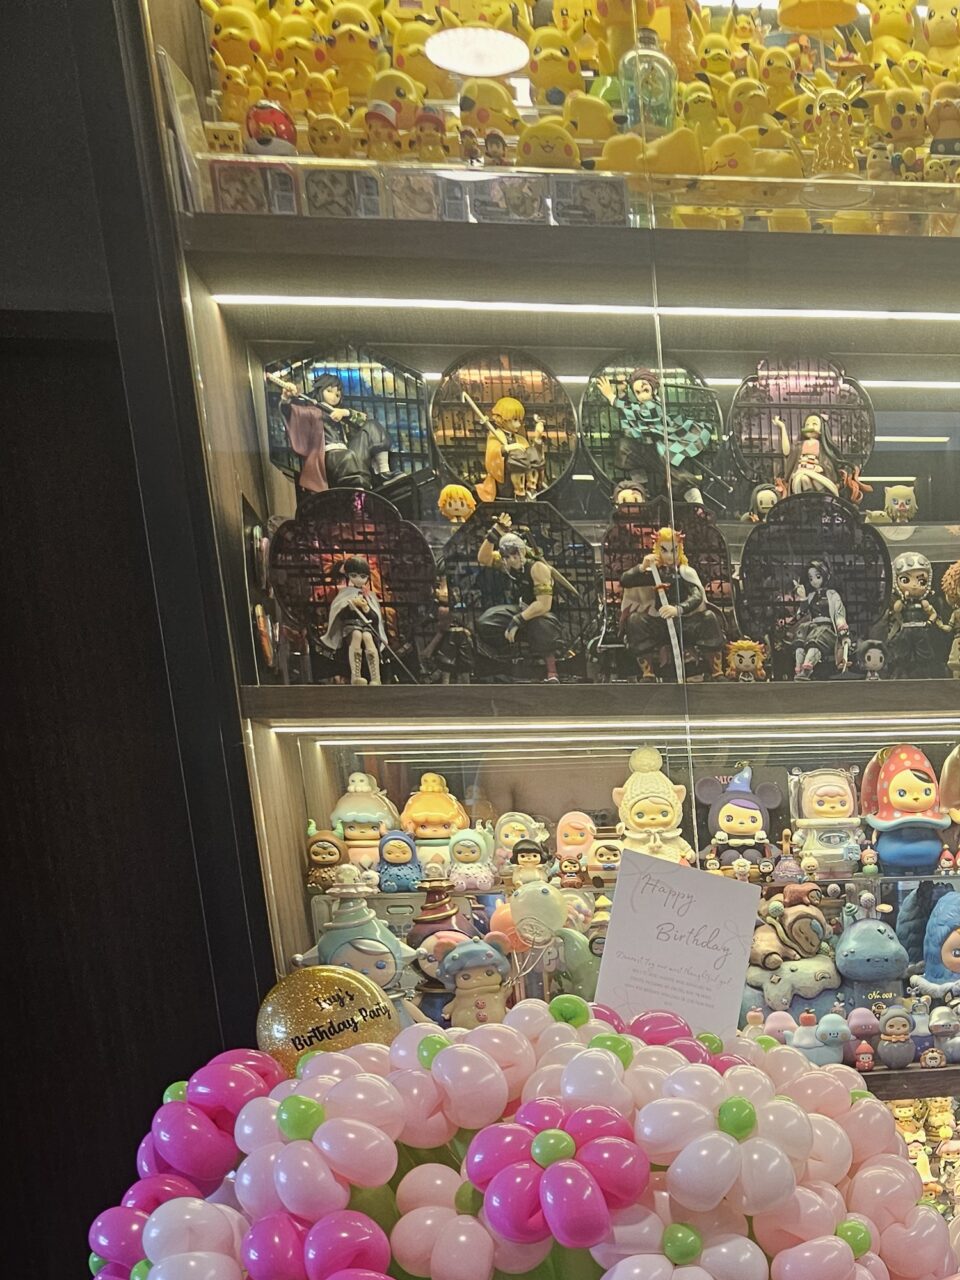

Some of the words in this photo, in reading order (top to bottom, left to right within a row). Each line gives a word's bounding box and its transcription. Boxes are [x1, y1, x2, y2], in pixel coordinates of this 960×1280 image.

[640, 873, 697, 917] Happy
[655, 921, 733, 970] Birthday
[290, 1016, 359, 1052] Birthday
[358, 1002, 392, 1022] Party
